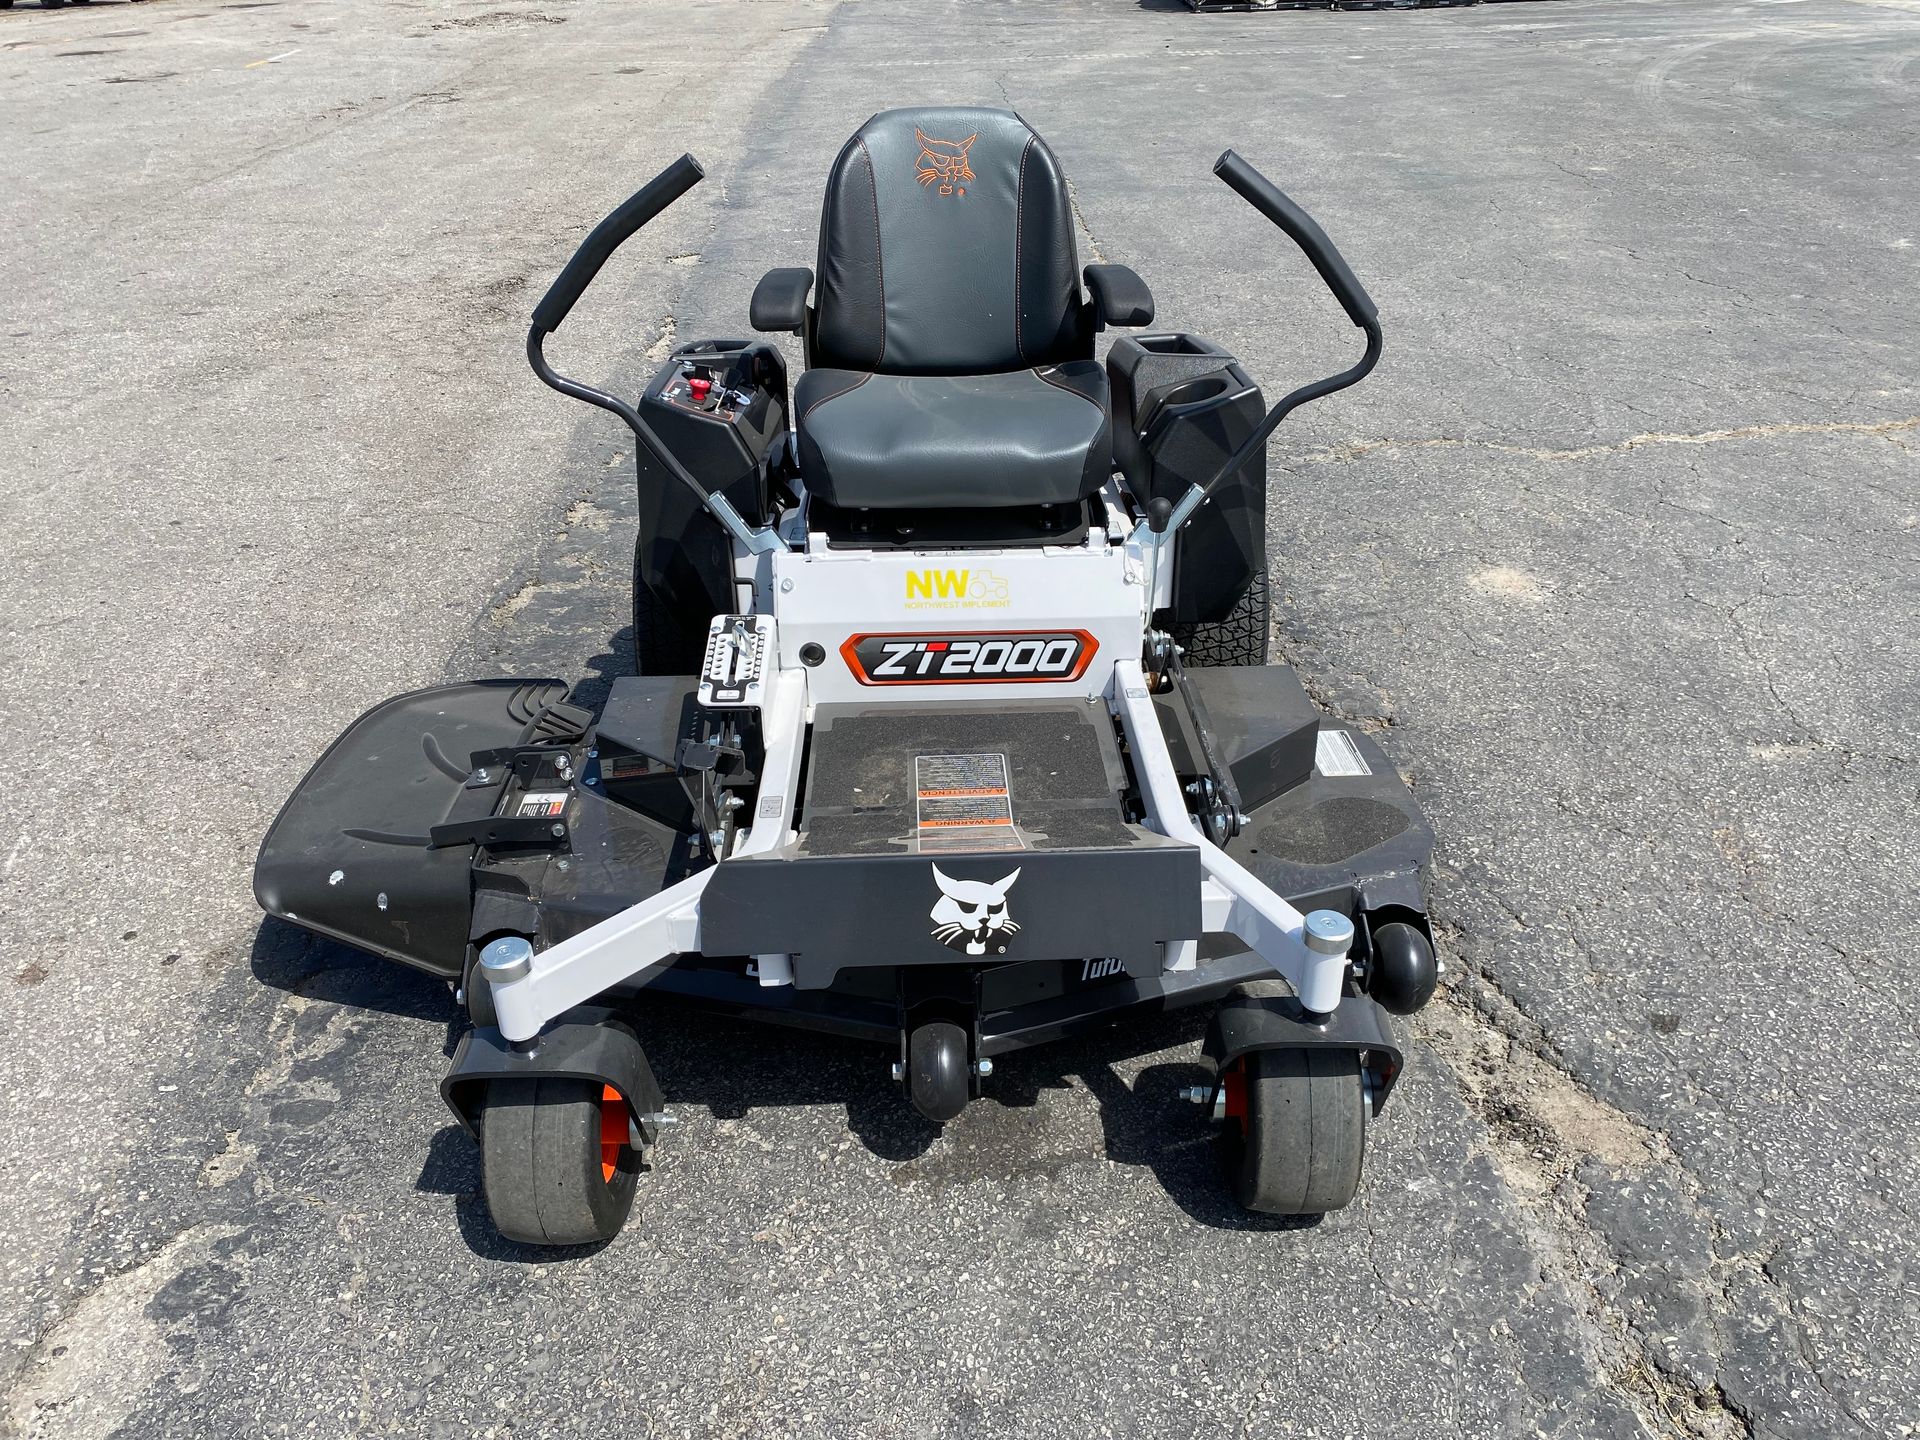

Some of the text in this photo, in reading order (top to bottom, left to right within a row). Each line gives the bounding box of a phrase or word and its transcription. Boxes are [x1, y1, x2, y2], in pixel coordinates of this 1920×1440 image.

[905, 569, 970, 599] NW
[904, 600, 1012, 609] NORTHWEST IMPLEMENT
[872, 639, 1079, 676] ZT2000
[1081, 957, 1126, 981] TufD
